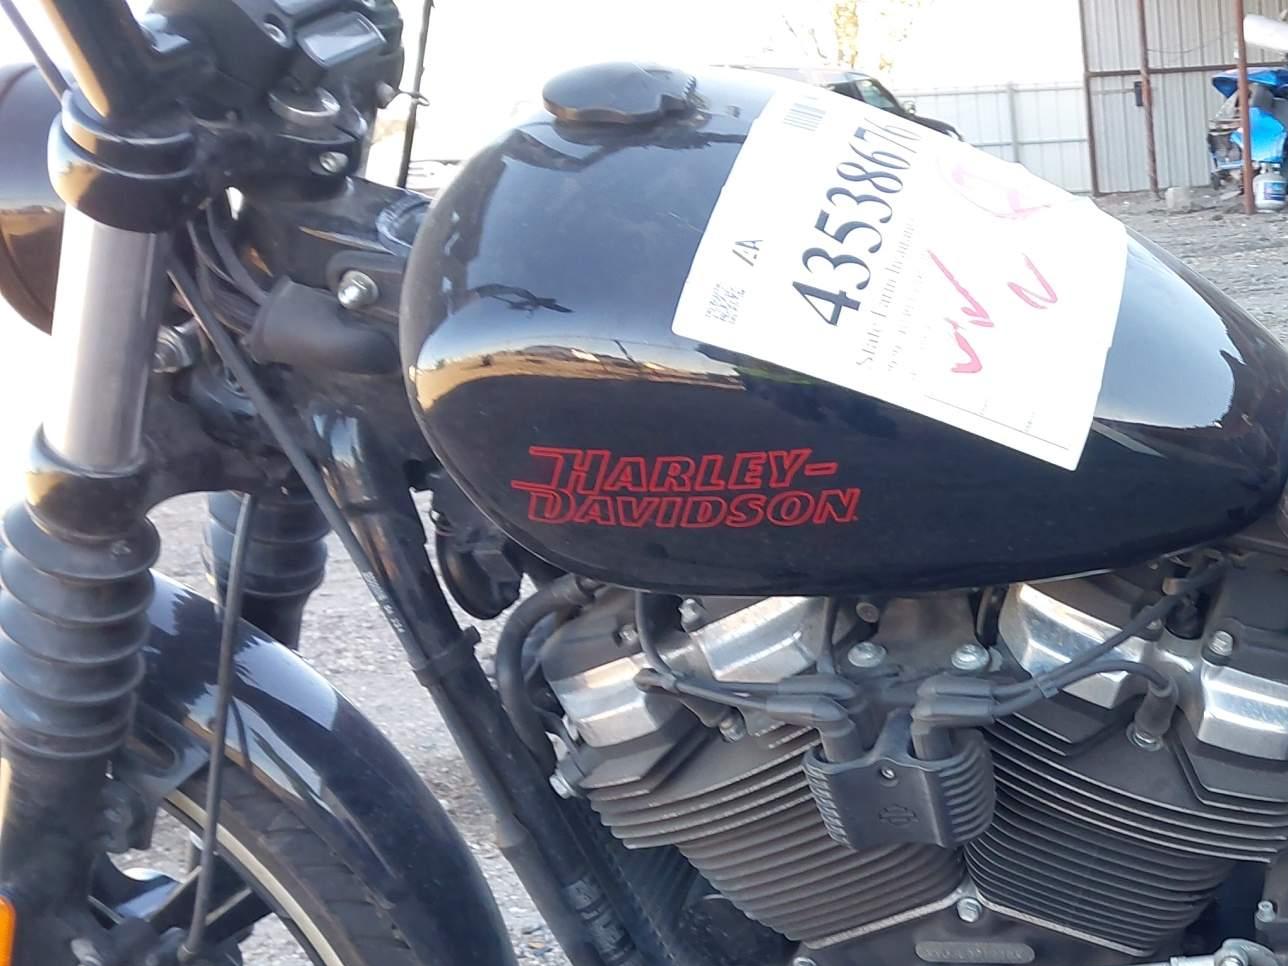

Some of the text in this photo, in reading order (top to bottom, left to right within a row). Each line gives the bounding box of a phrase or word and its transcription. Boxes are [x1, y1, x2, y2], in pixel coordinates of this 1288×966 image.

[792, 117, 921, 327] 43538676
[528, 446, 838, 495] HARLEY-
[510, 480, 861, 528] DAVIDSON
